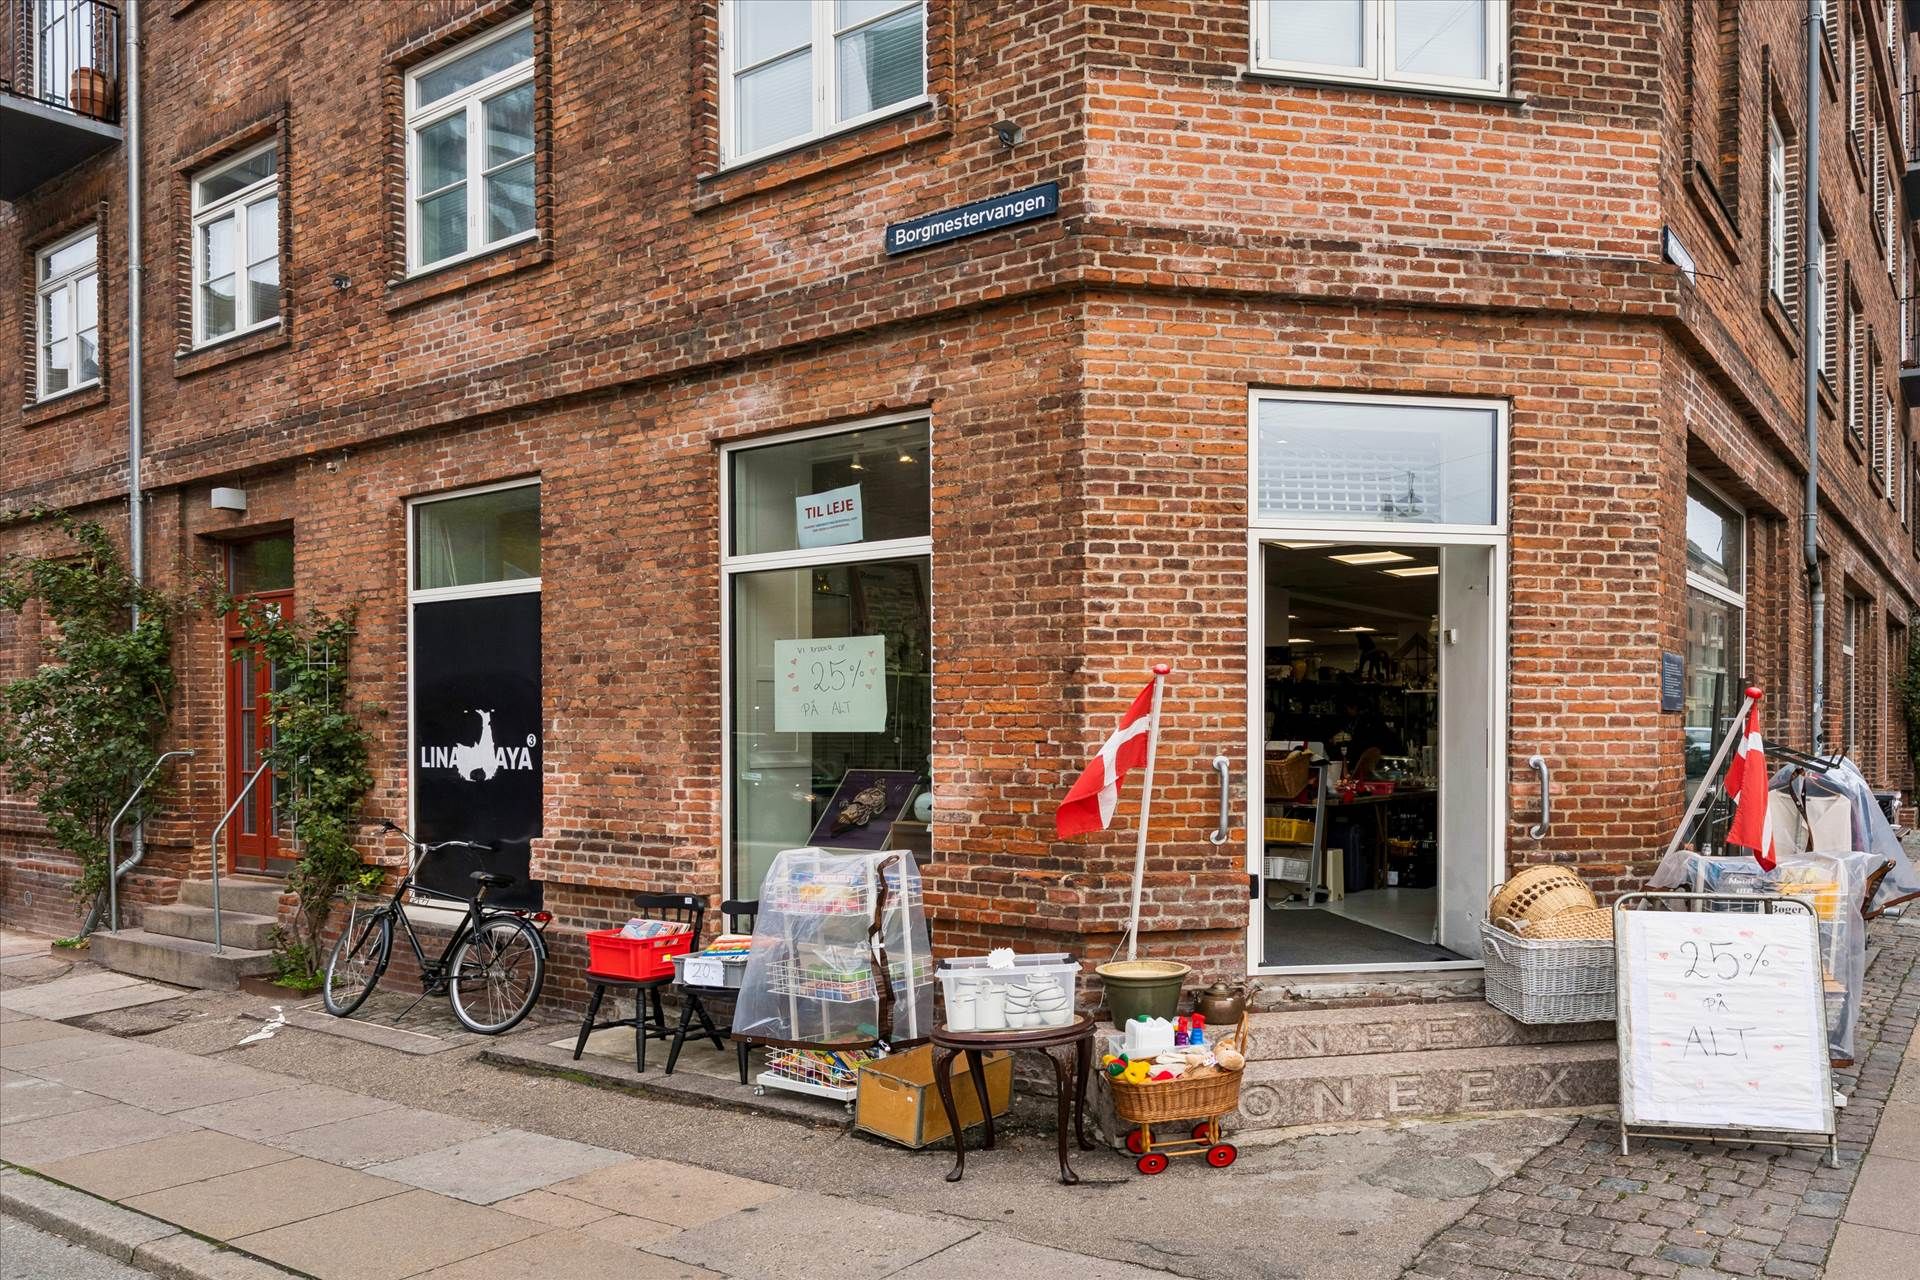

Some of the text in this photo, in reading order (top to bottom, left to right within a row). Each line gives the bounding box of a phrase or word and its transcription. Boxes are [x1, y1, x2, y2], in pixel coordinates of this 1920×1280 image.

[895, 195, 1046, 246] Borgmestervangen
[804, 498, 855, 519] TIL LEJE
[811, 658, 865, 693] 25%
[831, 700, 852, 715] ALT
[1680, 940, 1770, 980] 25%
[1703, 993, 1731, 1013] PÅ
[1684, 1026, 1757, 1061] ALT
